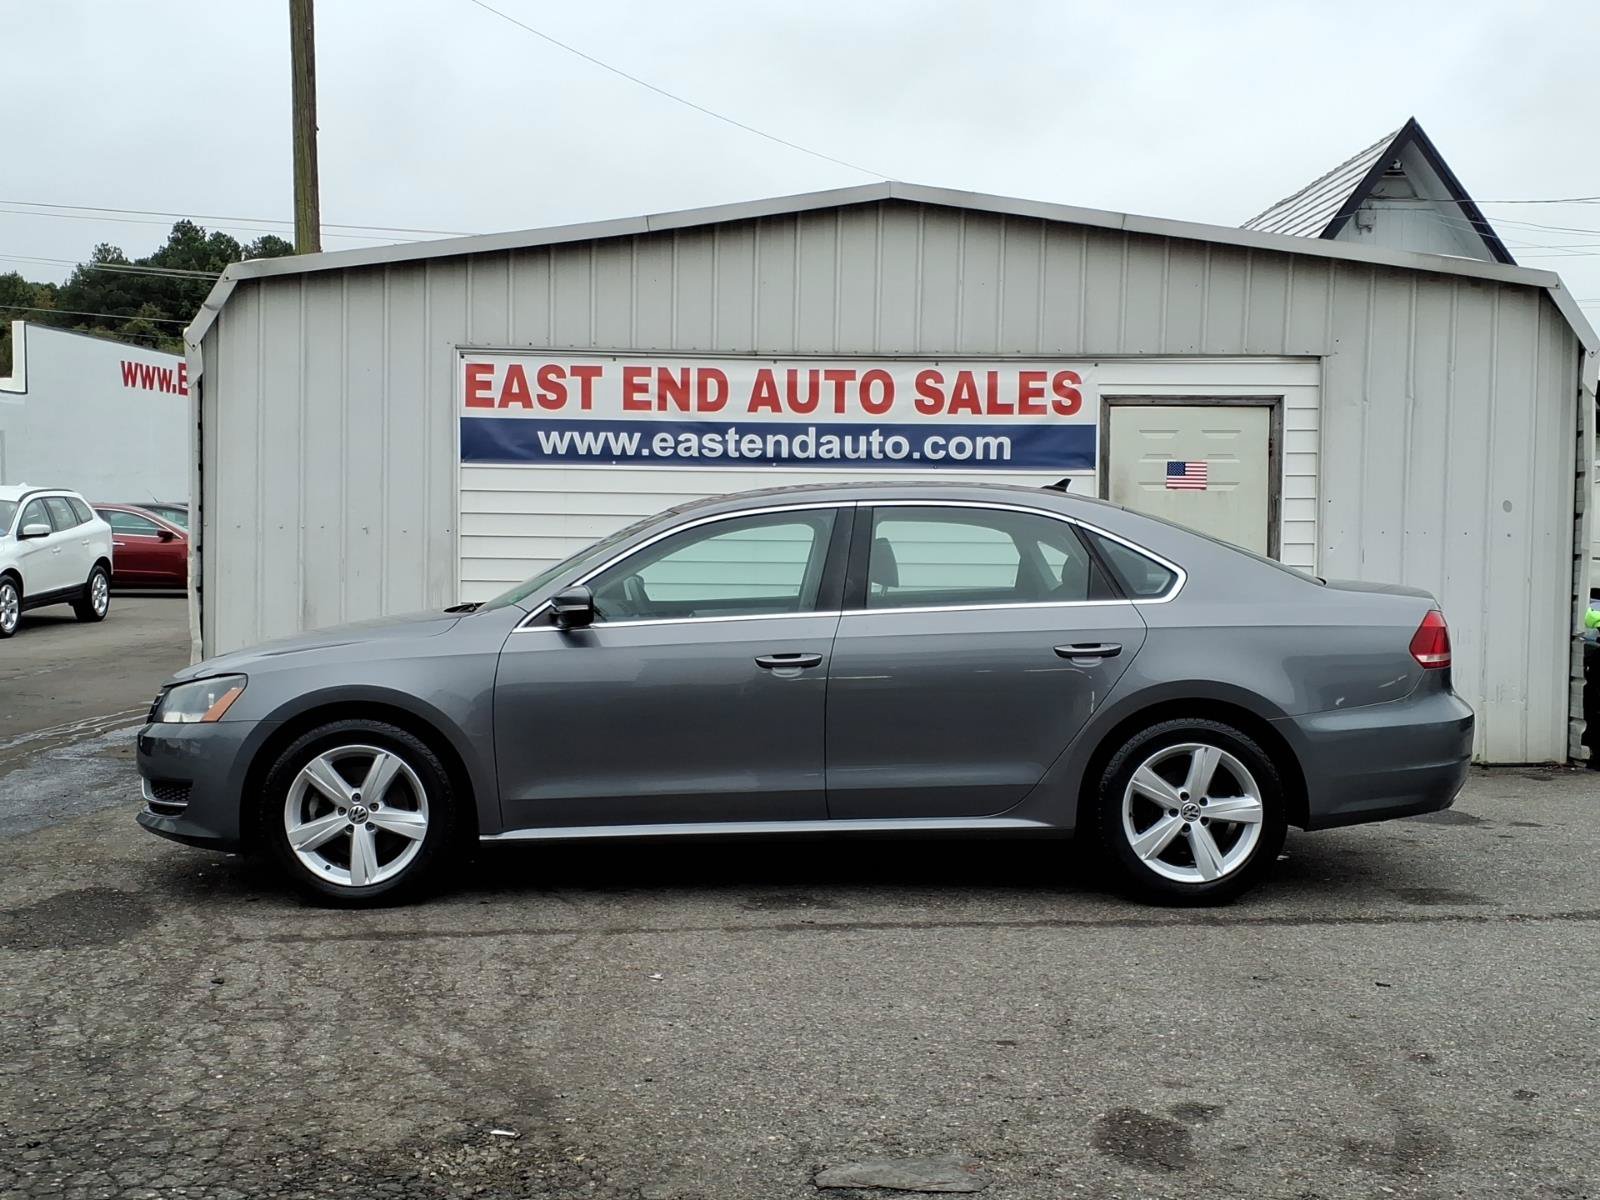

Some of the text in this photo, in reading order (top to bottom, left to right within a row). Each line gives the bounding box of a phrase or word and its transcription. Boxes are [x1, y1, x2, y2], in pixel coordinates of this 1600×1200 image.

[465, 363, 1083, 417] EAST END AUTO SALES
[537, 427, 1012, 460] www.eastendauto.com
